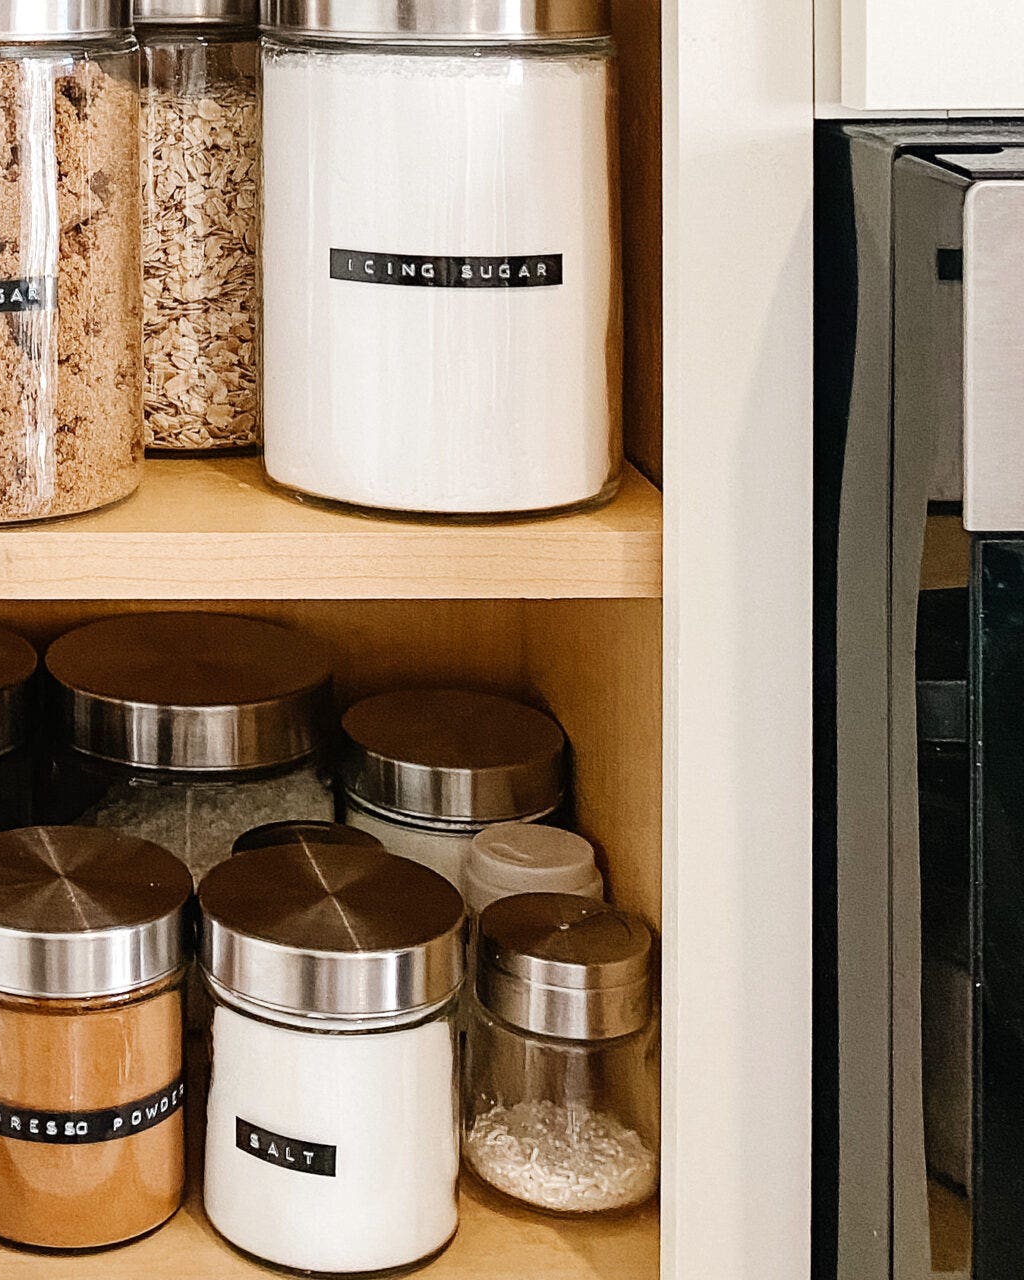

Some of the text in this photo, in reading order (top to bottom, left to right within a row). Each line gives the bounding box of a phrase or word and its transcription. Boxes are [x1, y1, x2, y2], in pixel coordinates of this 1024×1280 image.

[348, 258, 547, 279] ICING SUGAR
[249, 1133, 315, 1165] SALT
